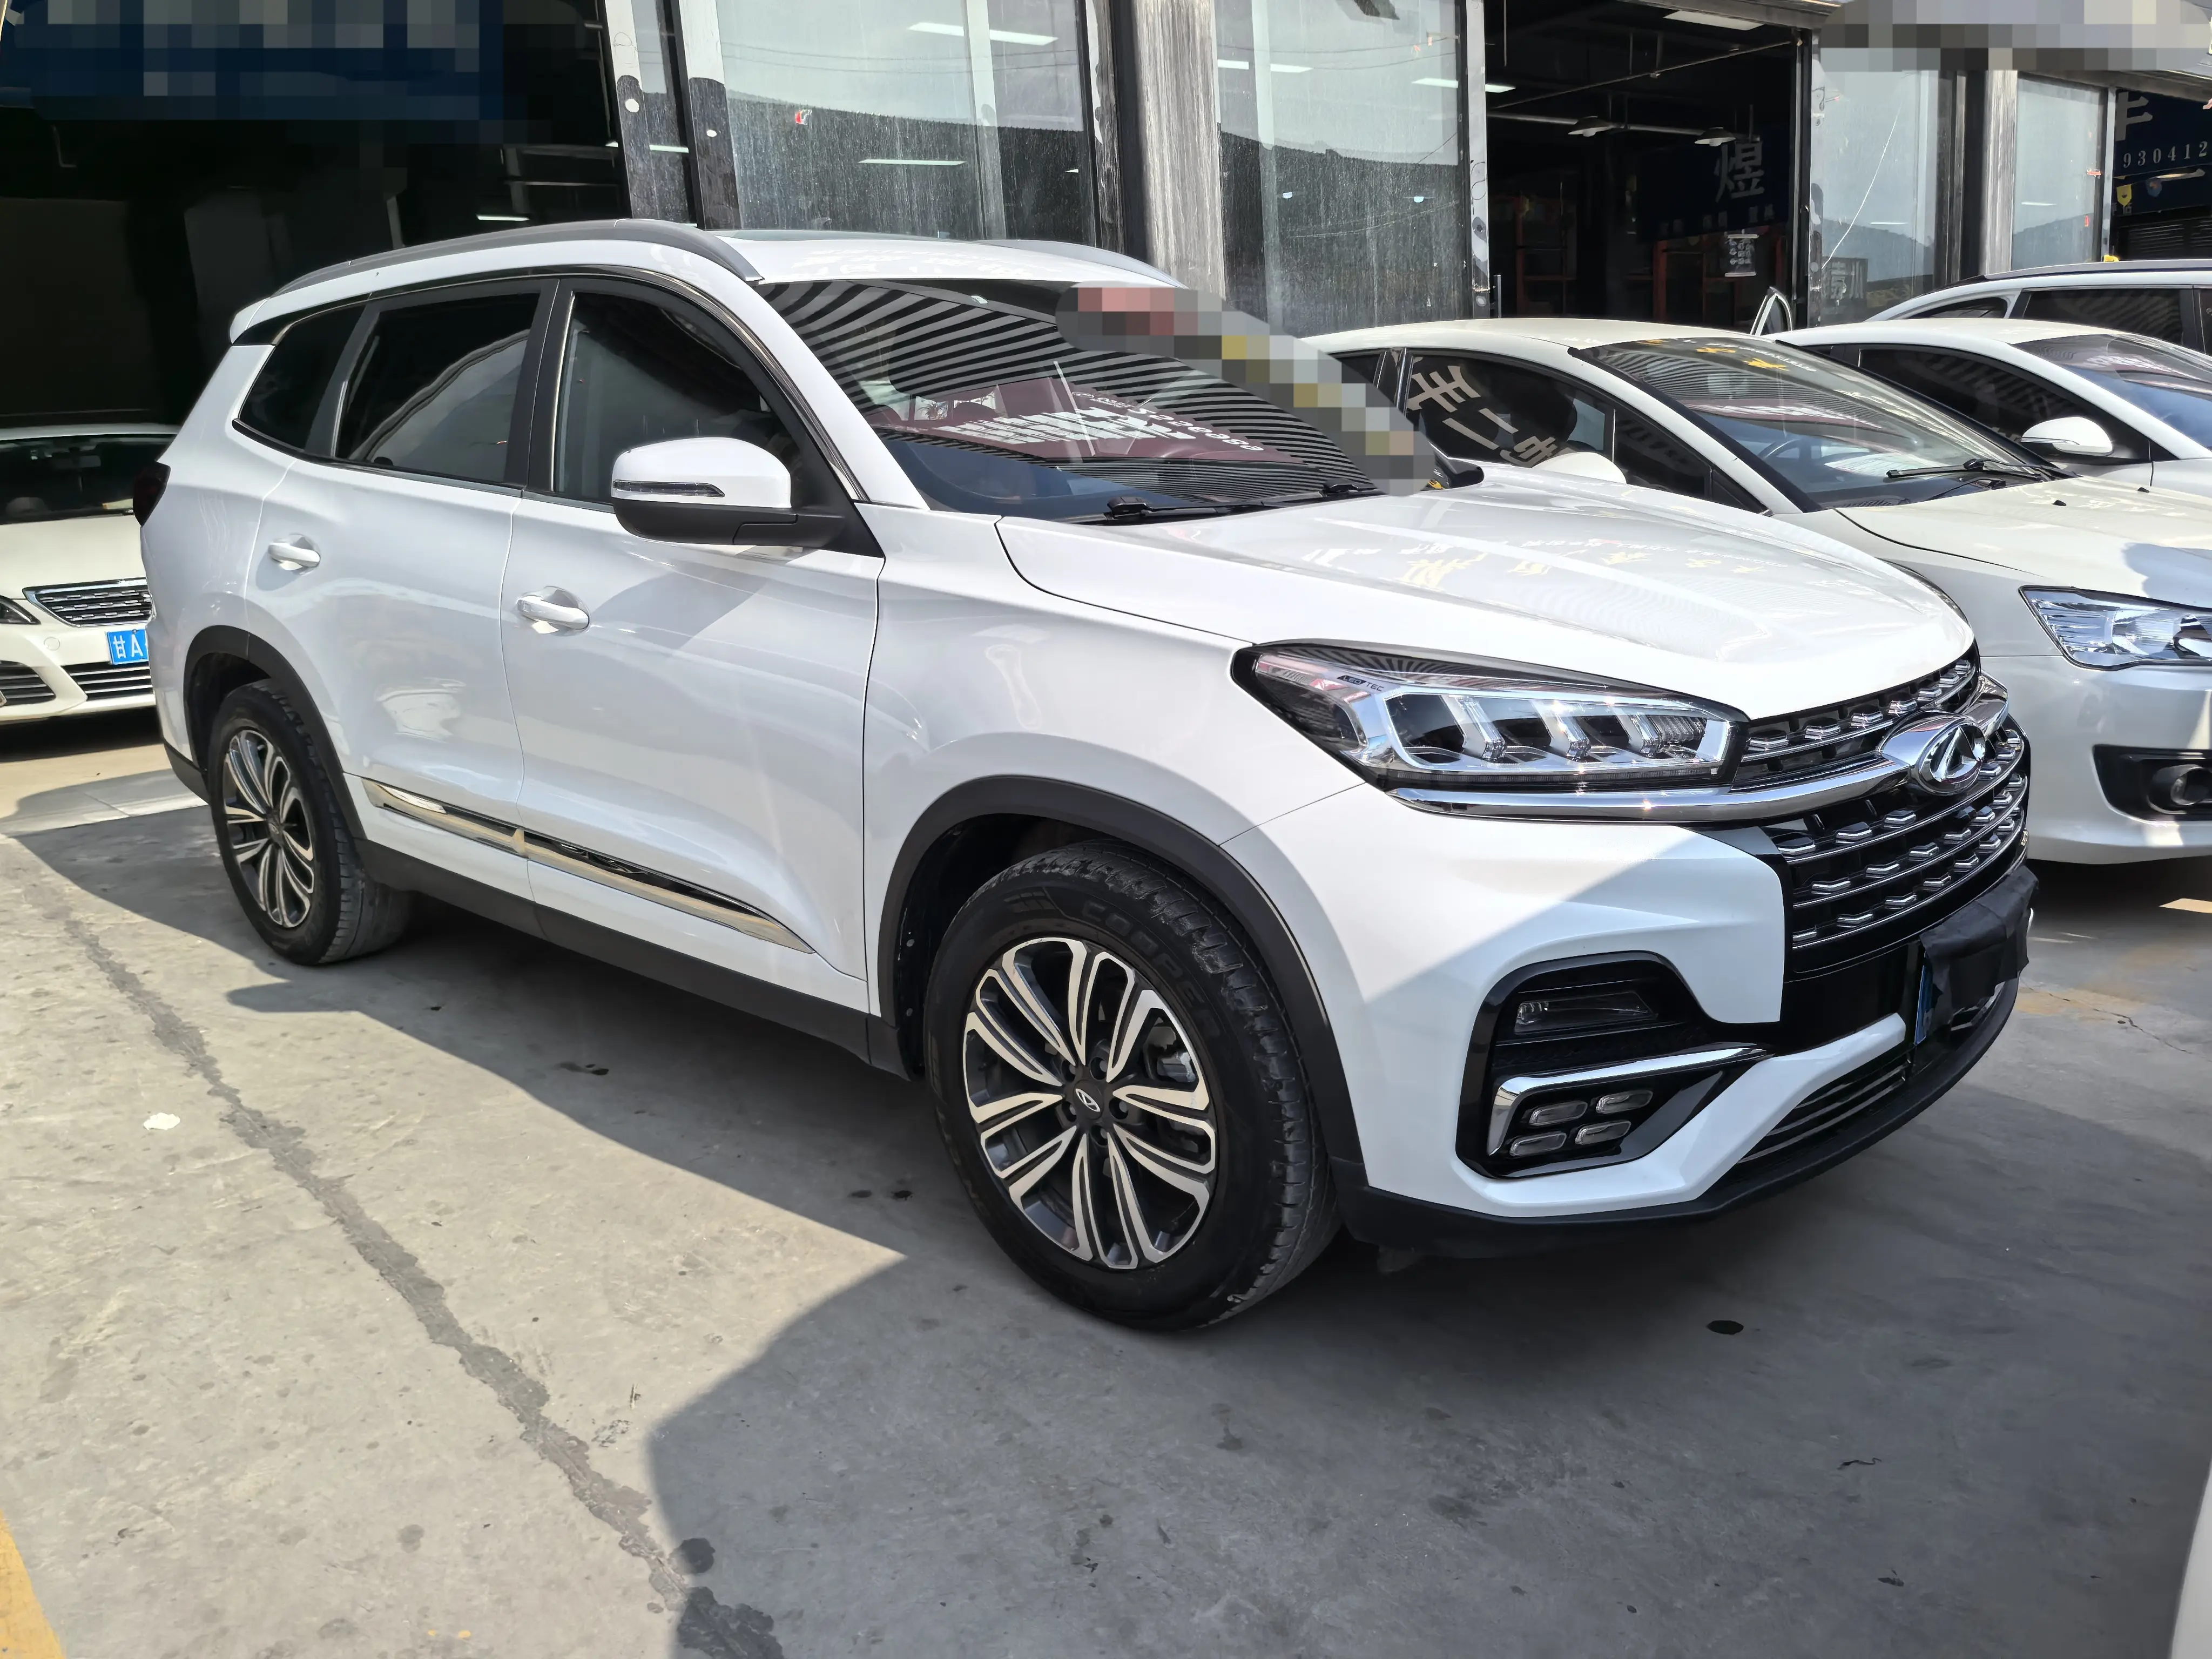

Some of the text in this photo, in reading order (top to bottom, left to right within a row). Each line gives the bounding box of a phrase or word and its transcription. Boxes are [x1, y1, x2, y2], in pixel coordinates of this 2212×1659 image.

[2123, 141, 2208, 168] 930412
[113, 634, 144, 659] 甘A
[1343, 676, 1384, 692] LED TEC
